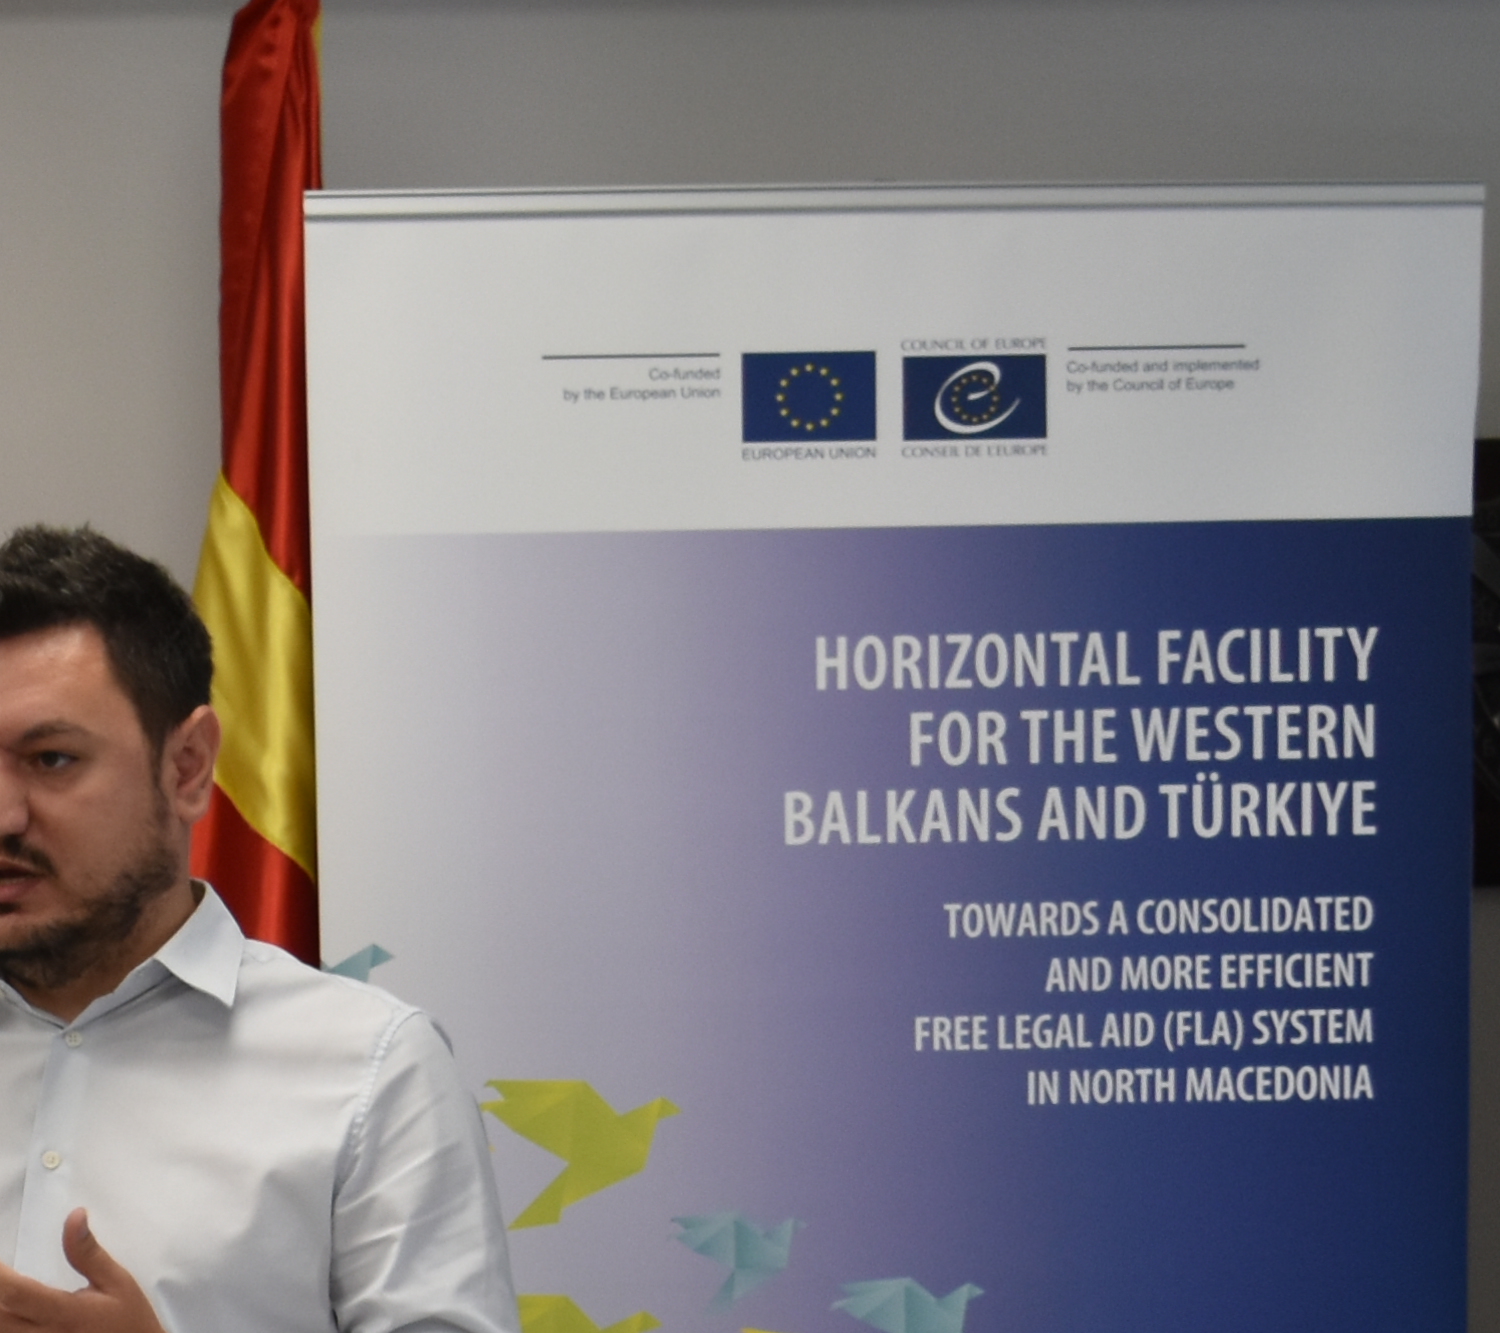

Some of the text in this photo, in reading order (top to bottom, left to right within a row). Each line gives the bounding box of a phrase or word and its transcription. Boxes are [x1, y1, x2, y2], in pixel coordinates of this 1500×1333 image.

[901, 338, 1046, 351] COUNCIL OF EUROPE
[649, 367, 721, 381] Co-funded
[1067, 359, 1260, 374] Co-funded and implemented
[562, 386, 721, 404] by the European Union
[1067, 378, 1234, 394] by the Council of Europe
[742, 447, 876, 461] EUROPEAN UNION
[901, 446, 961, 458] CONSEIL
[966, 446, 982, 457] DE
[814, 626, 1379, 692] HORIZONTAL FACILITY
[909, 703, 1375, 767] FOR THE WESTERN
[783, 771, 1377, 846] BALKANS AND TÜRKIYE
[942, 895, 1374, 939] TOWARDS A CONSOLIDATED
[1045, 951, 1374, 993] AND MORE EFFICIENT
[914, 1008, 1373, 1052] FREE LEGAL AID (FLA) SYSTEM
[1027, 1064, 1374, 1106] IN NORTH MACEDONIA
